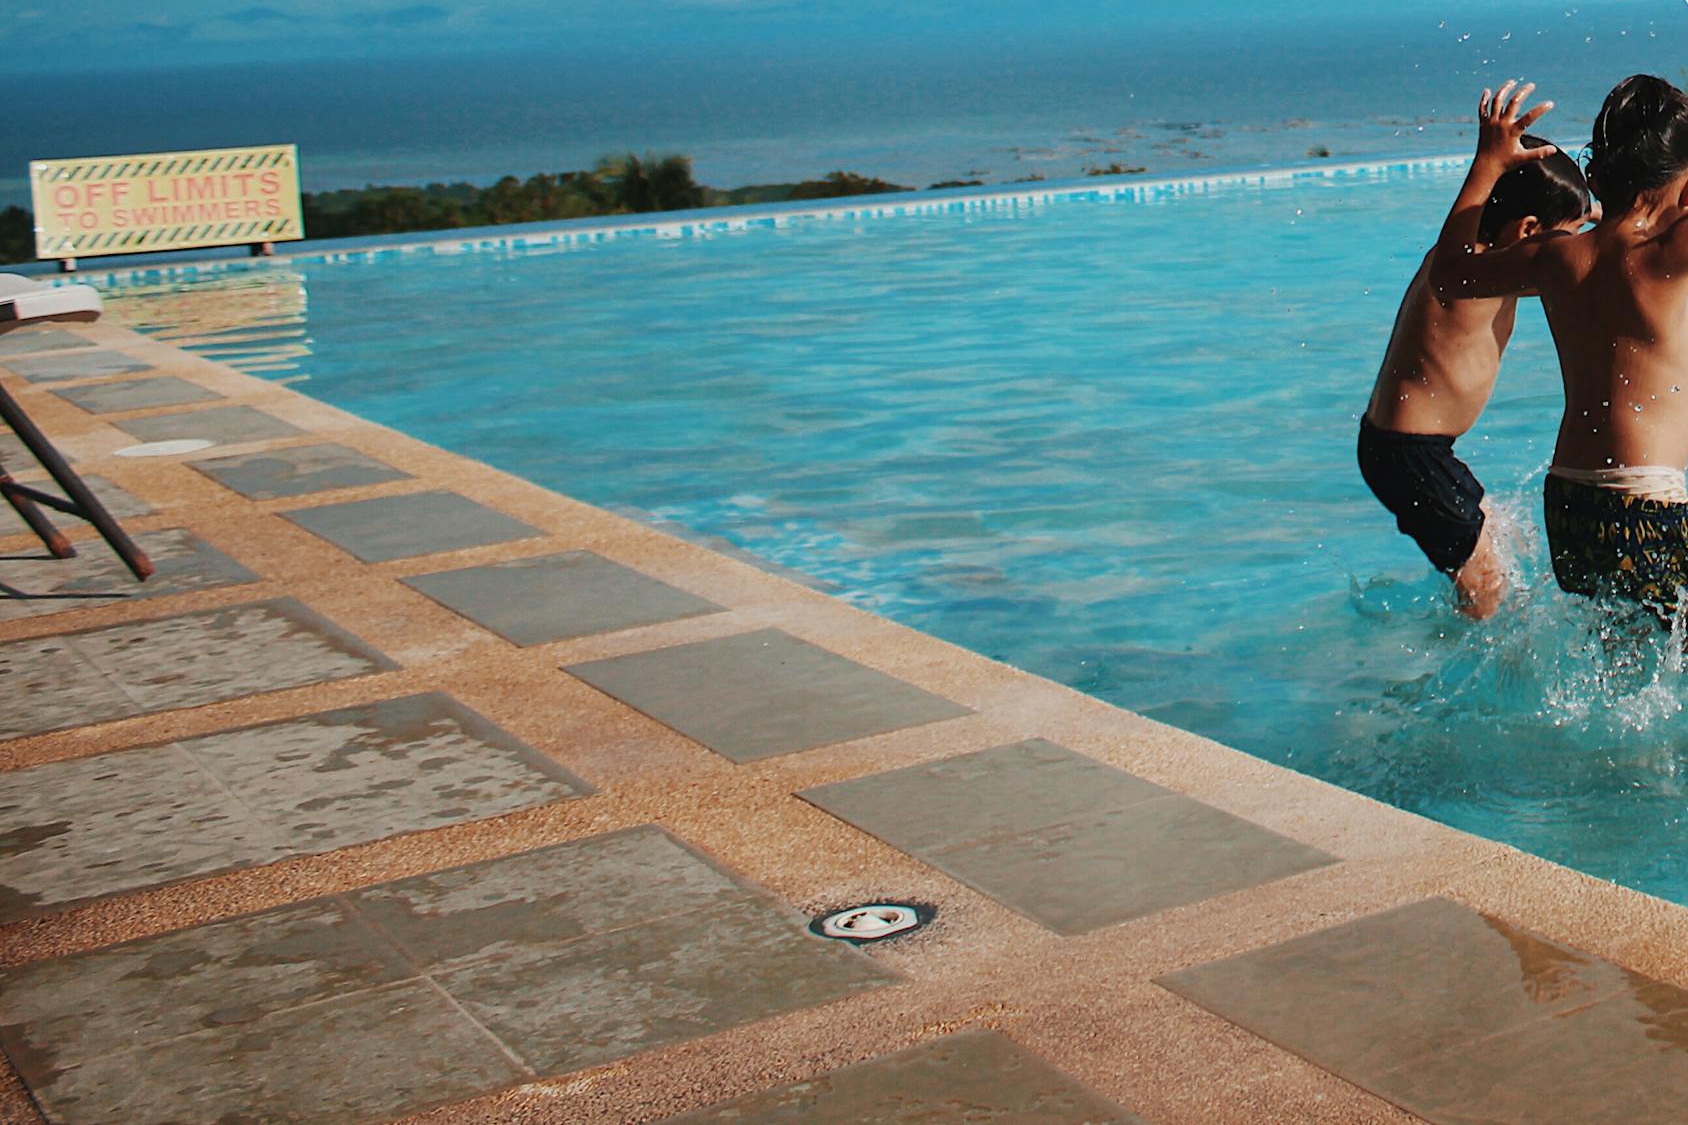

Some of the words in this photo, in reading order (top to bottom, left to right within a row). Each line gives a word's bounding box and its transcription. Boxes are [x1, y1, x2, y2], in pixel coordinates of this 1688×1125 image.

[54, 182, 129, 208] OFF
[148, 171, 281, 202] LIMITS
[57, 212, 99, 229] TO
[112, 199, 281, 227] SWIMMERS
